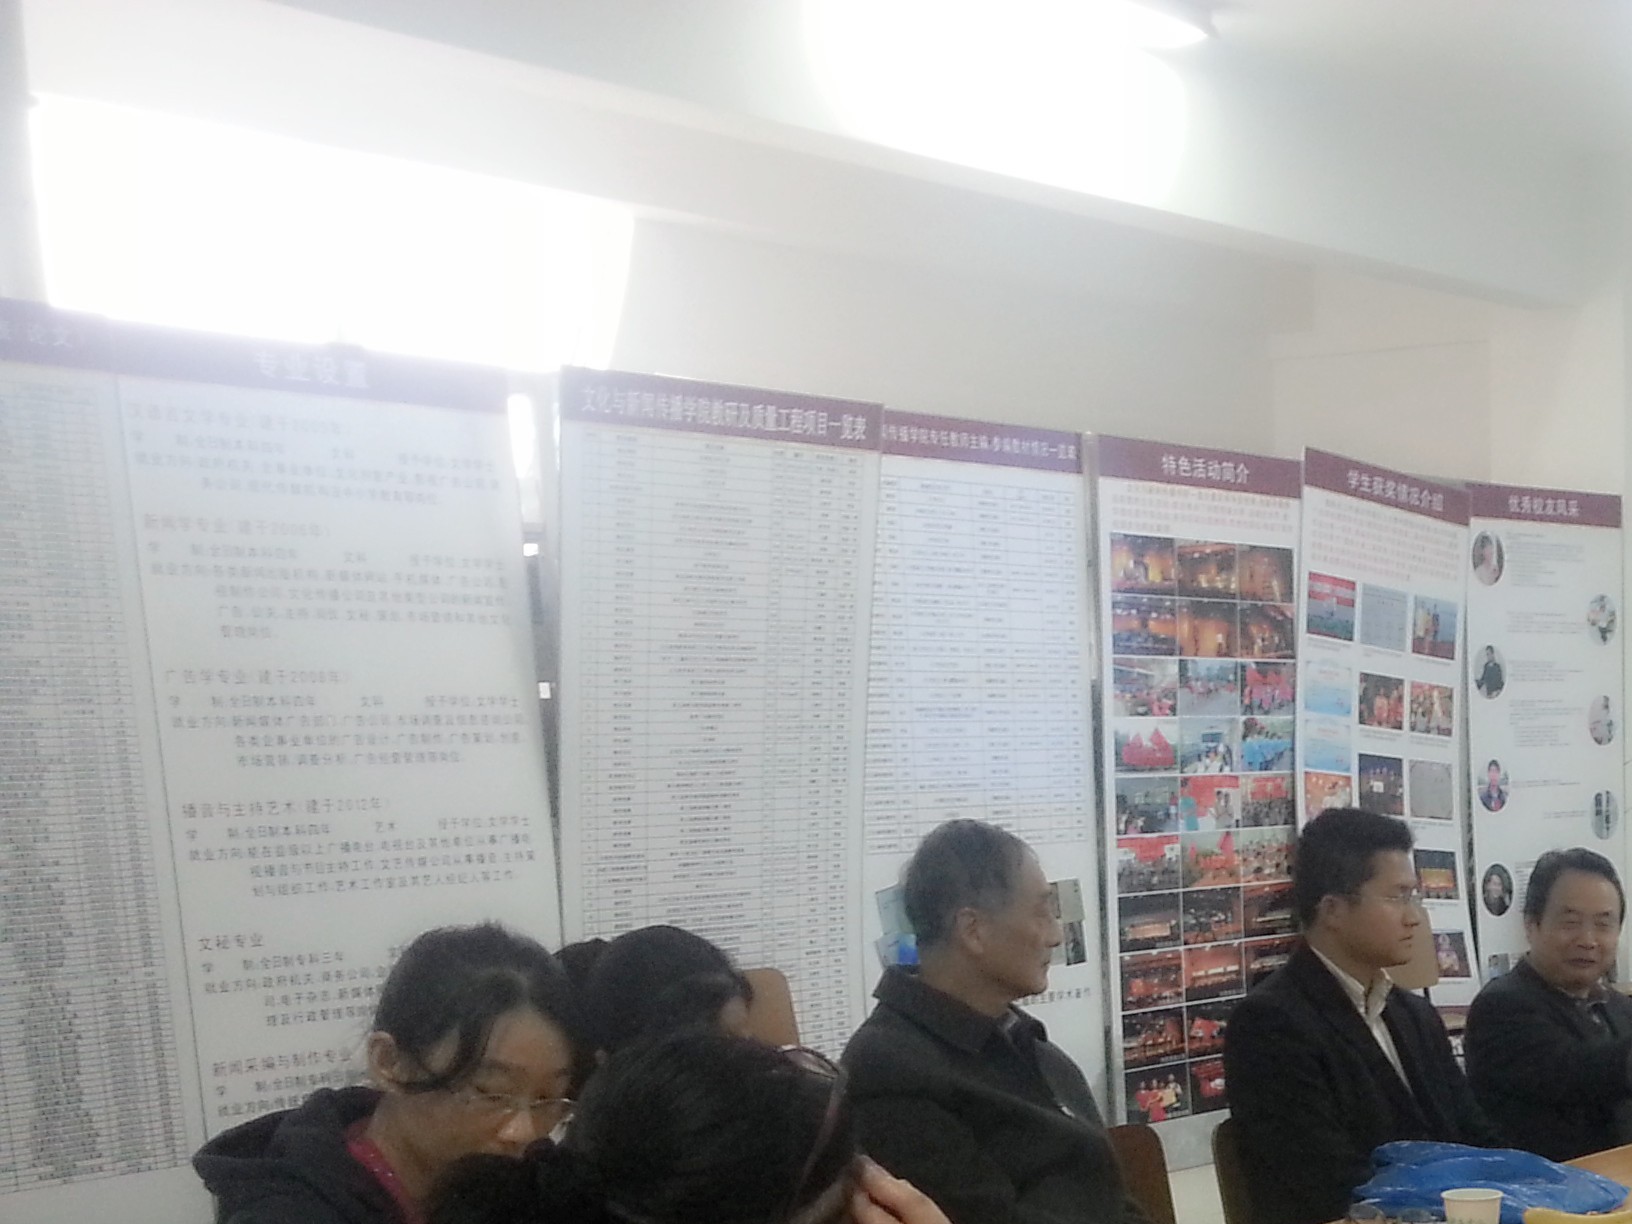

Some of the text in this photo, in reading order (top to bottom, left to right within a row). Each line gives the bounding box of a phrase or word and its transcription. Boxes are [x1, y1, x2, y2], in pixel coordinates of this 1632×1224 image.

[254, 352, 370, 389] 专业设置
[1162, 455, 1249, 484] 特色活动简介
[1347, 469, 1444, 511] 学生获奖情况介绍
